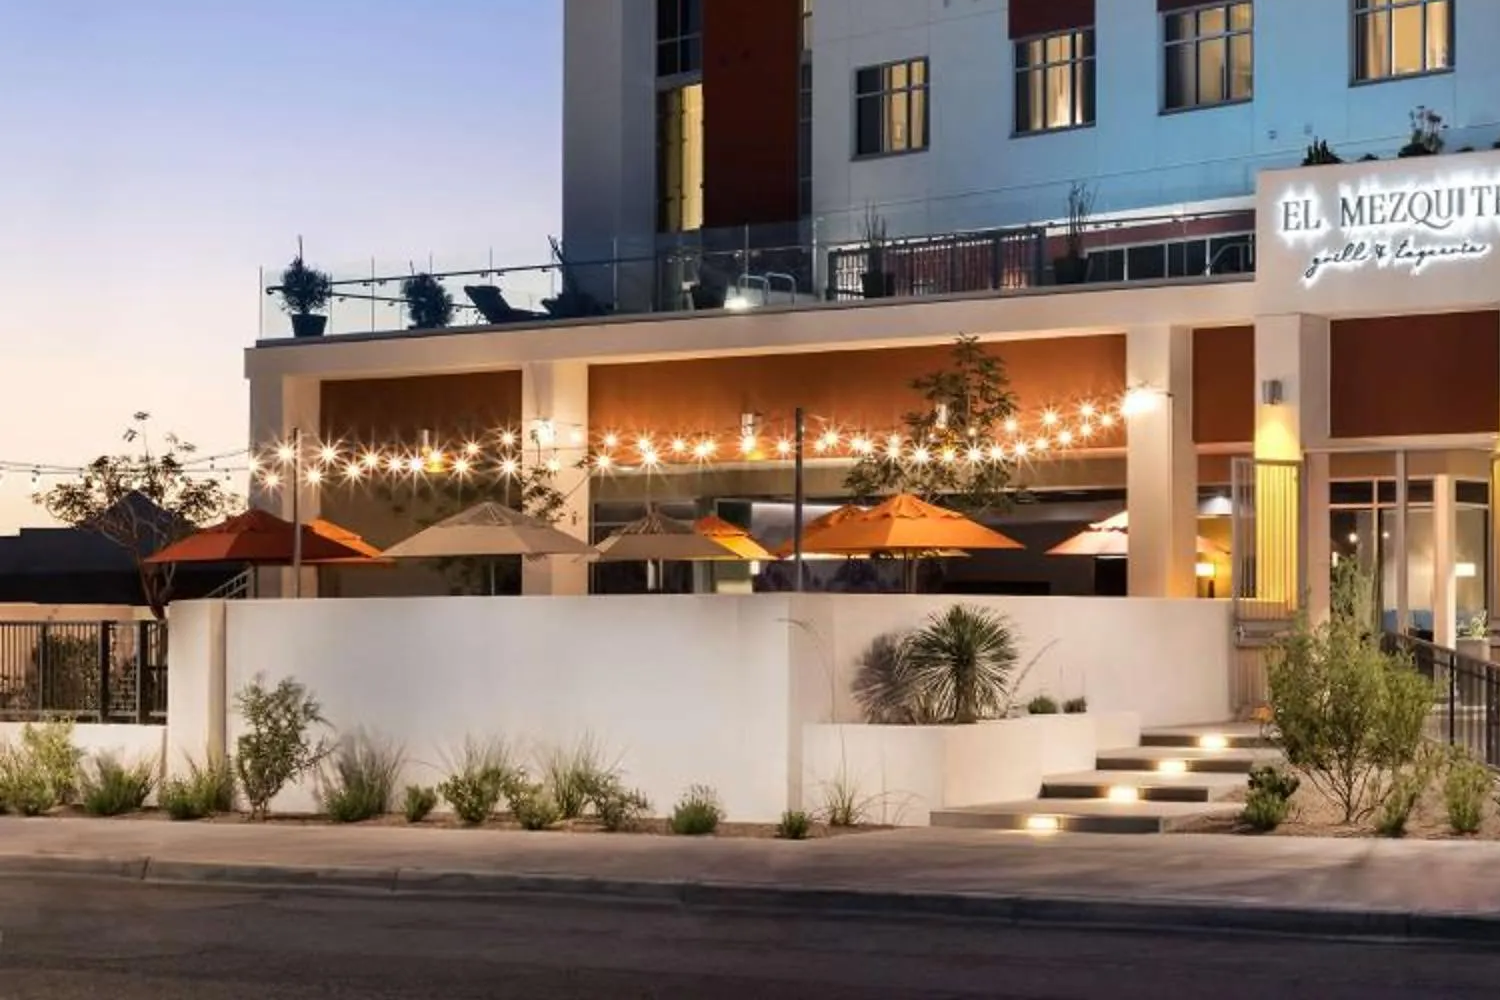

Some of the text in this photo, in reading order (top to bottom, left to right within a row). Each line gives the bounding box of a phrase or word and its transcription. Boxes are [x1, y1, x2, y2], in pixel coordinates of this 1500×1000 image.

[1283, 199, 1321, 232] EL
[1304, 241, 1368, 279] grill
[1374, 243, 1386, 259] &
